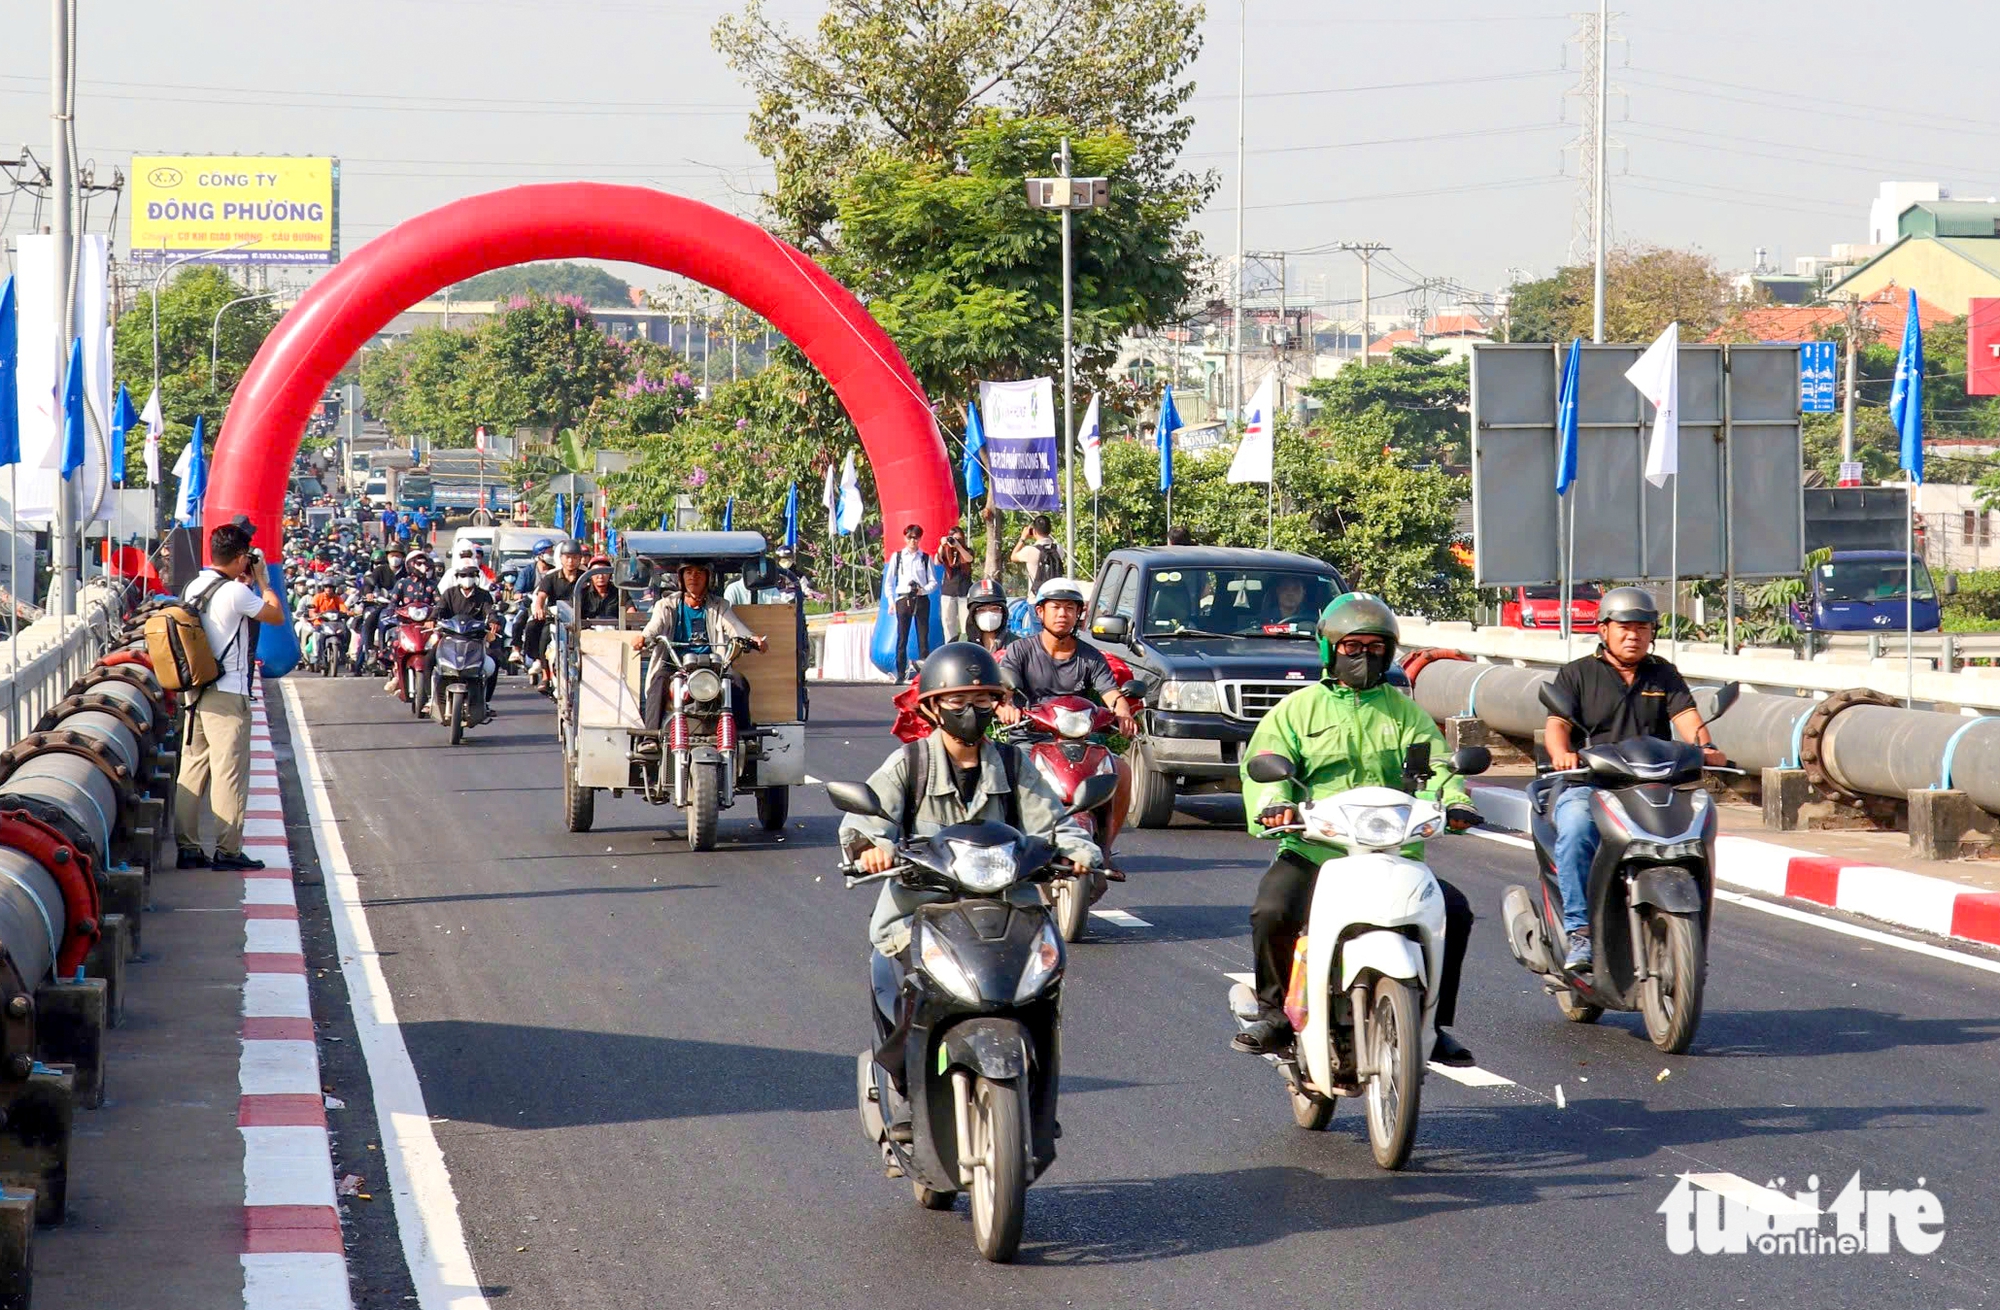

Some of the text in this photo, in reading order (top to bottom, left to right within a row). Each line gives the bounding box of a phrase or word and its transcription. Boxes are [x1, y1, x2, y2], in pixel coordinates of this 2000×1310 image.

[199, 171, 277, 187] CÔNG TY
[223, 199, 323, 221] PHƯƠNG
[1180, 433, 1218, 448] HONDA
